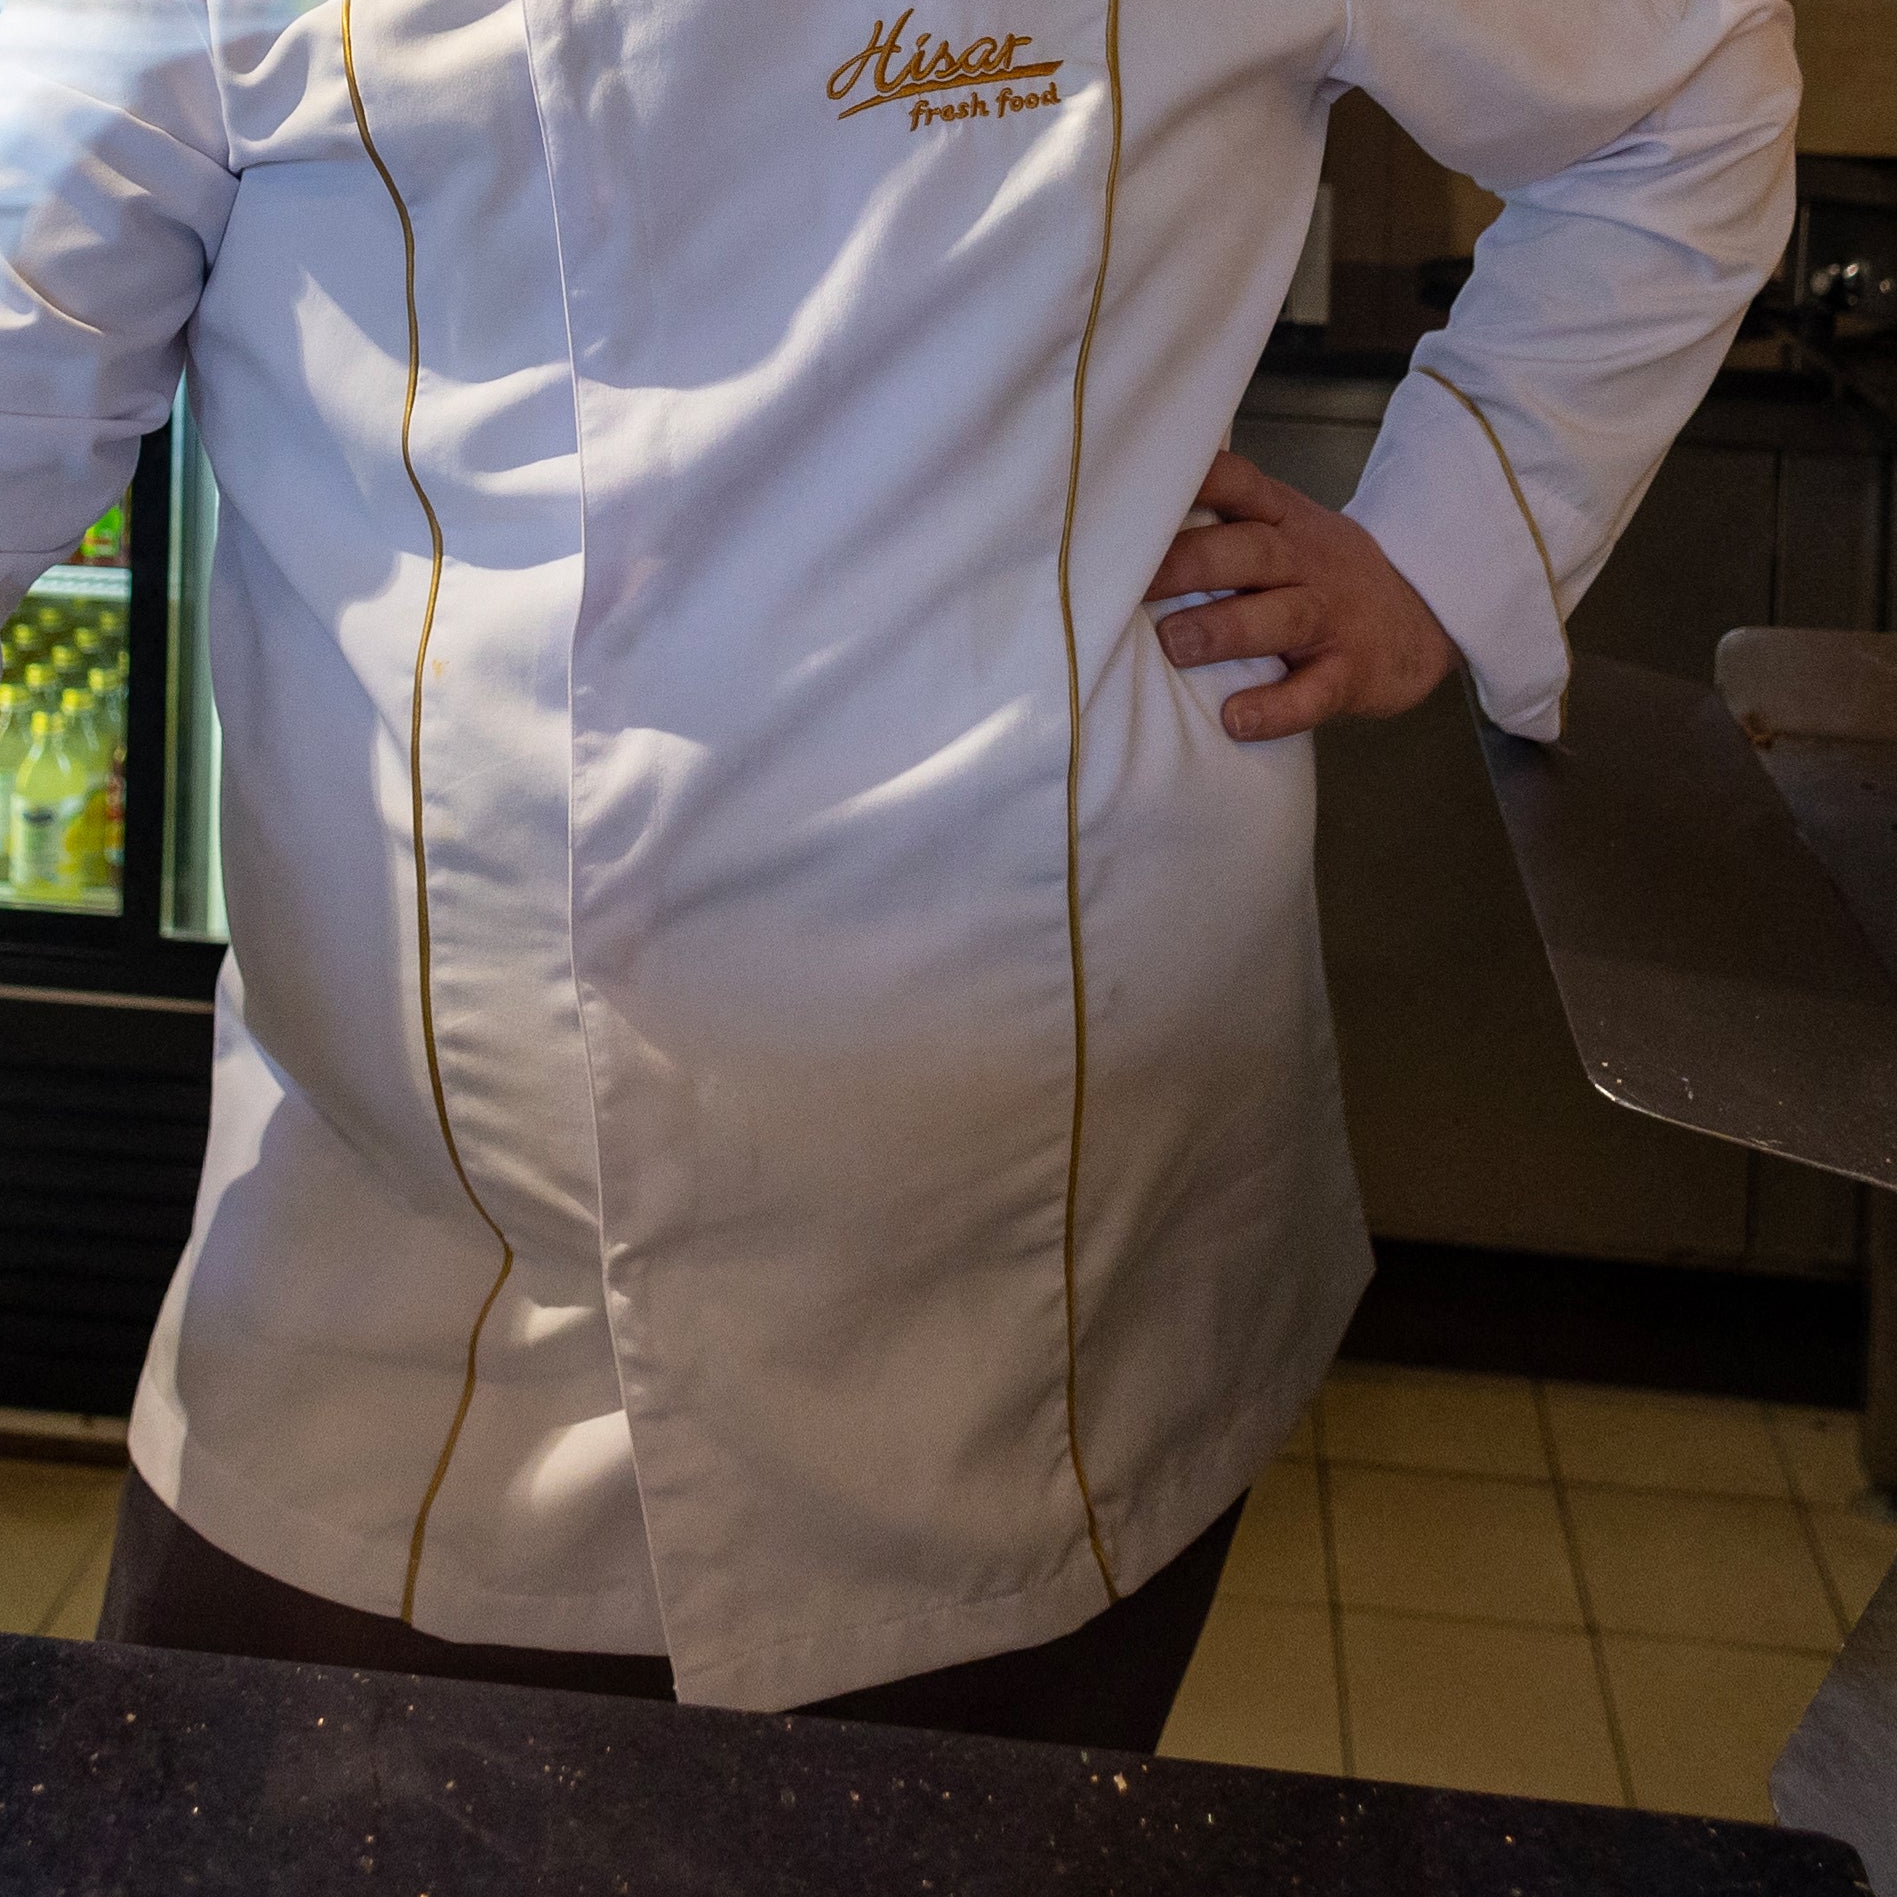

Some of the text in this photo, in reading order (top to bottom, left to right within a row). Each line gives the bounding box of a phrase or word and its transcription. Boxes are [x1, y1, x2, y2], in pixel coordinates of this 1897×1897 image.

[826, 8, 1032, 100] Hisar
[908, 82, 1061, 132] fresh food
